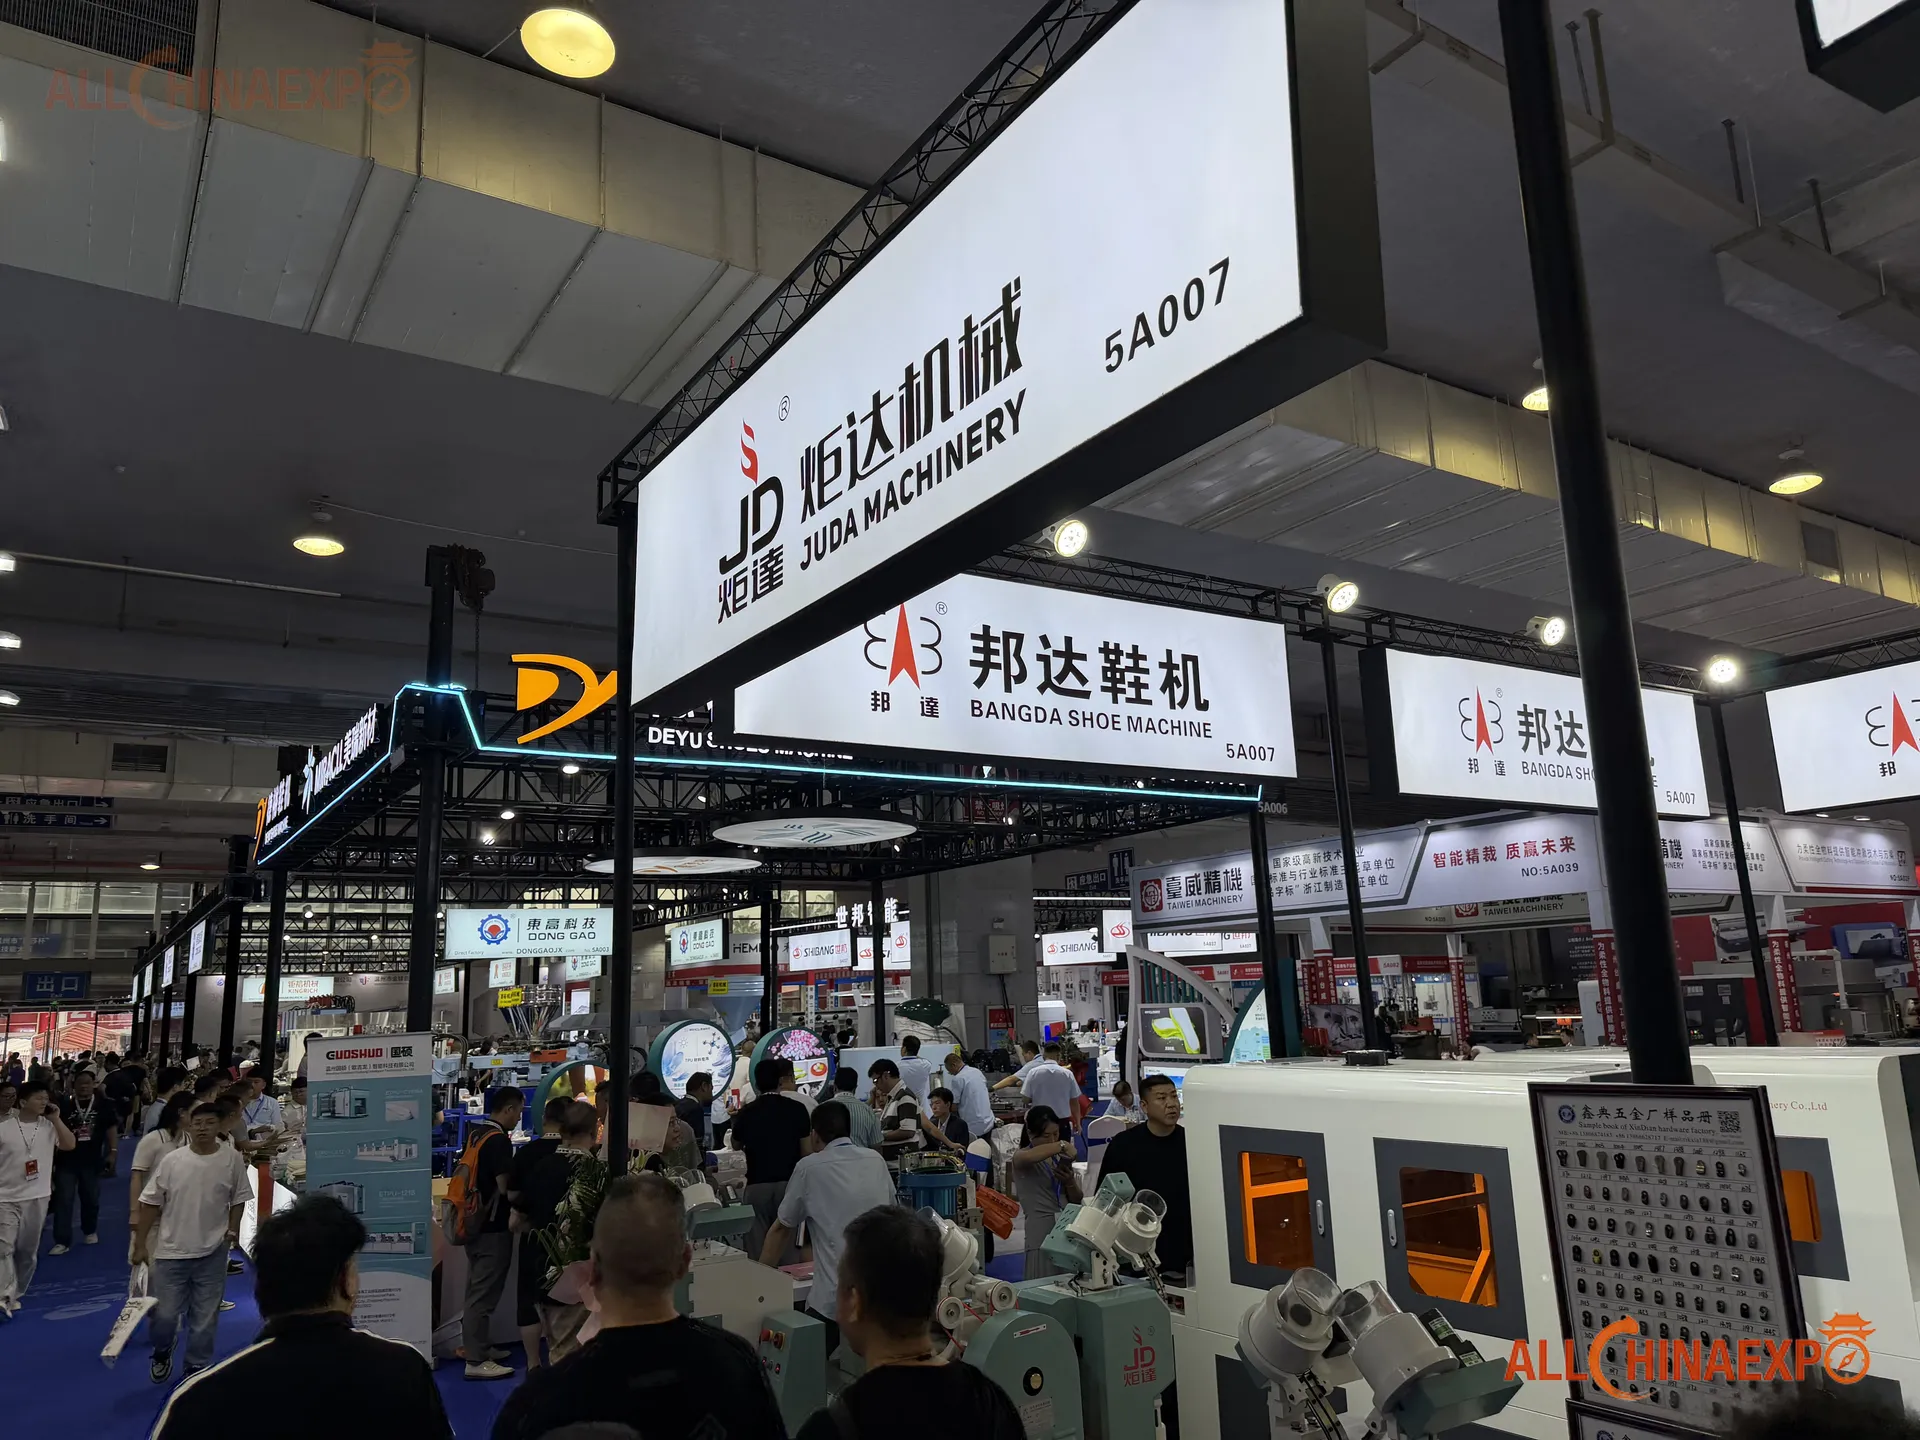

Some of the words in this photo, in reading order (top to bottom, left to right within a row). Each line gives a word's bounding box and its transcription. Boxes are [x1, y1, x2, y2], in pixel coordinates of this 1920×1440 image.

[1104, 257, 1230, 373] 5A007
[799, 275, 1023, 524] 炬达机械
[799, 512, 858, 571] JUDA
[863, 388, 1027, 531] MACHINERY
[719, 476, 785, 576] JD
[717, 544, 784, 624] 炬達
[969, 624, 1210, 712] 邦达鞋机
[870, 690, 940, 719] 邦達
[970, 699, 1062, 726] BANGDA
[1068, 707, 1121, 731] SHOE
[1126, 714, 1212, 740] MACHINE
[648, 727, 702, 748] DEYU
[1226, 742, 1276, 762] 5A007
[1467, 757, 1507, 777] 邦達
[1521, 761, 1573, 779] BANGDA
[1575, 766, 1597, 782] SH
[1666, 790, 1696, 806] 5A007
[1258, 803, 1288, 814] 5A006
[23, 815, 77, 825] 洗手间
[1272, 846, 1364, 869] 国家级高新技术业
[1433, 846, 1497, 868] 智能精裁
[1506, 835, 1576, 860] 质赢未来
[1521, 862, 1579, 877] NO:5A039
[1079, 873, 1106, 886] 应急出口
[1167, 900, 1193, 911] TAIWEI
[1195, 894, 1244, 908] MACHINERY
[1483, 908, 1511, 916] TAIWEI
[1513, 903, 1564, 914] MACHINERY
[526, 917, 596, 930] 東高科技
[528, 932, 565, 941] DONG
[570, 932, 596, 940] GAO
[804, 945, 835, 957] SHIBANG
[1060, 942, 1096, 954] SHIBANG
[36, 975, 79, 992] 出口
[326, 1048, 383, 1060] GUOSHUO
[391, 1046, 413, 1058] 国硕
[1581, 1104, 1712, 1124] 鑫典五金厂样品册
[1578, 1121, 1601, 1131] Sample
[1602, 1122, 1619, 1131] book
[1629, 1124, 1656, 1132] XinDian
[1658, 1125, 1689, 1134] hardware
[1124, 1346, 1155, 1371] JD
[1124, 1368, 1156, 1387] 炬達
